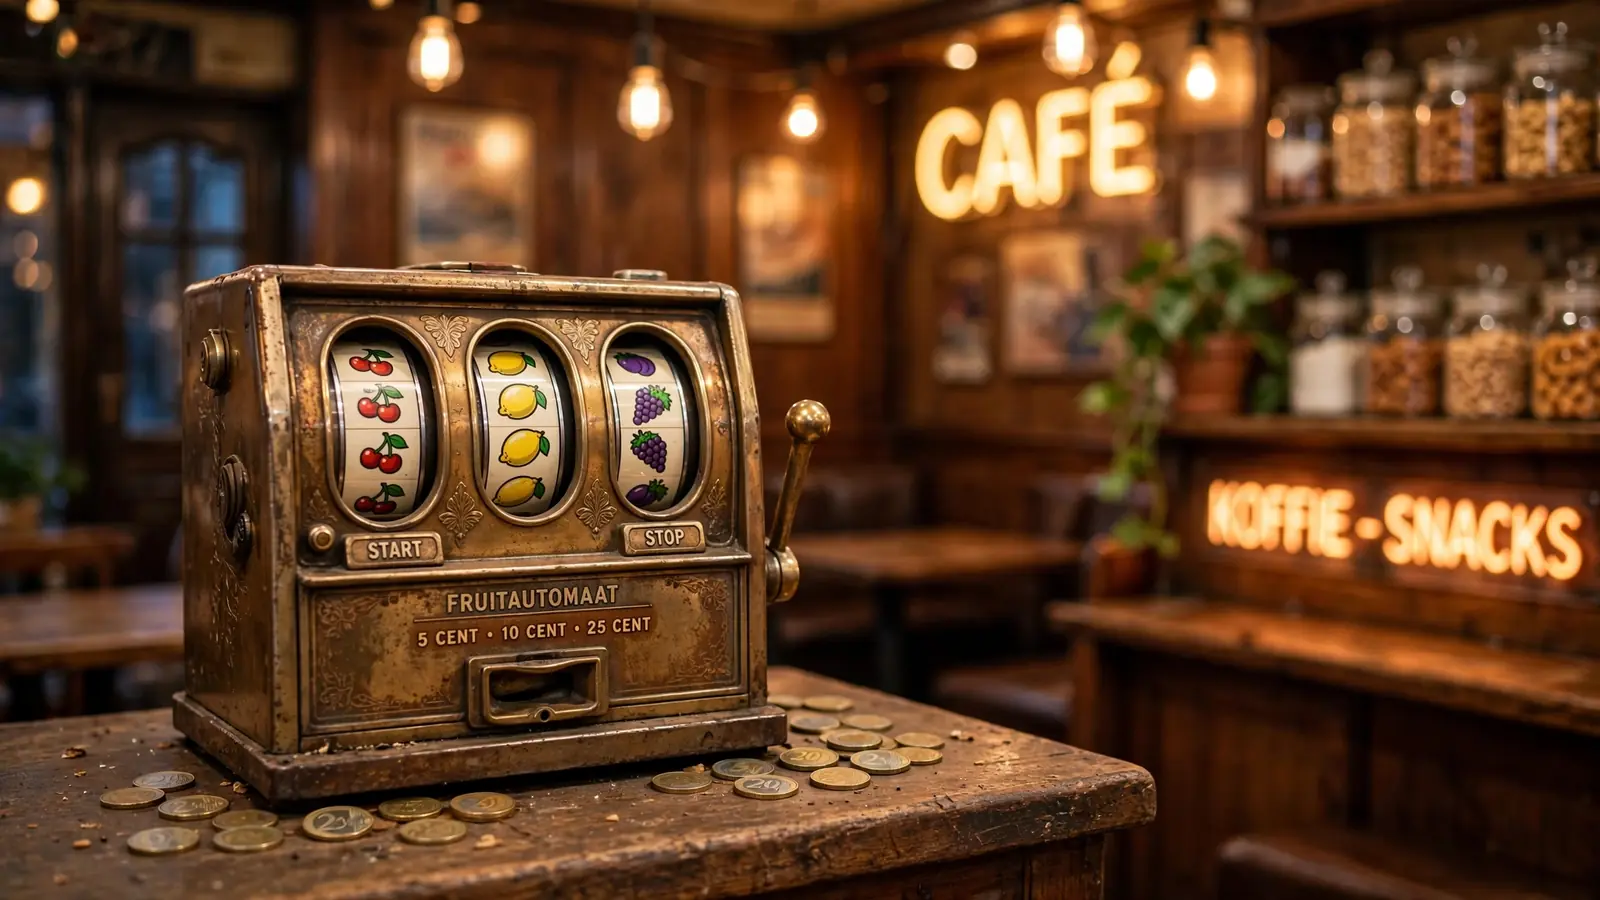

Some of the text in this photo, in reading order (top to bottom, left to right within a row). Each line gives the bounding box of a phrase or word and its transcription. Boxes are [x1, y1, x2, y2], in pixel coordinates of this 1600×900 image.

[915, 41, 1156, 220] CAFÉ
[367, 540, 422, 560] START
[645, 529, 685, 546] STOP
[446, 584, 619, 613] FRUITAUTOMAAT
[417, 616, 651, 647] 5 CENT 10 CENT 25 CENT
